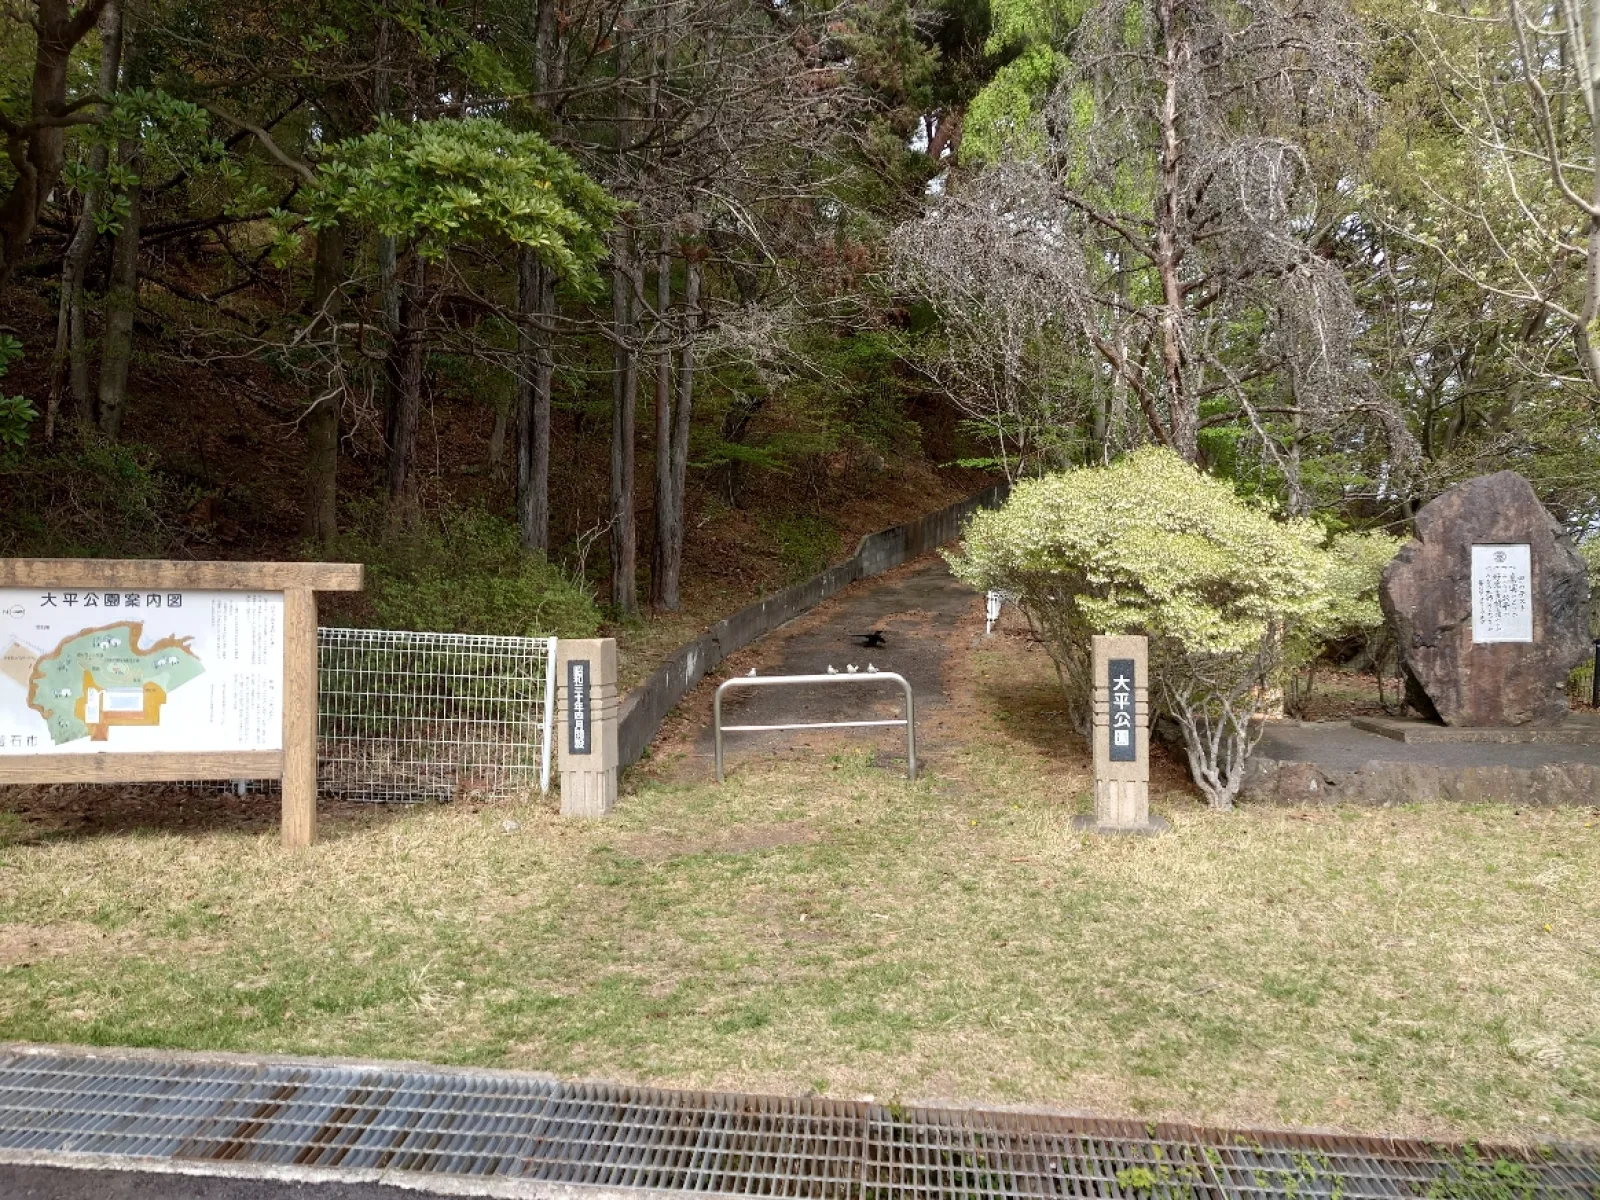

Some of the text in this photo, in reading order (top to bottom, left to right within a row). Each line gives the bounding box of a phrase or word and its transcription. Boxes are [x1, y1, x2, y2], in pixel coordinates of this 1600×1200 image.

[40, 592, 183, 608] 大平公園案内図
[1112, 674, 1131, 746] 大平公園
